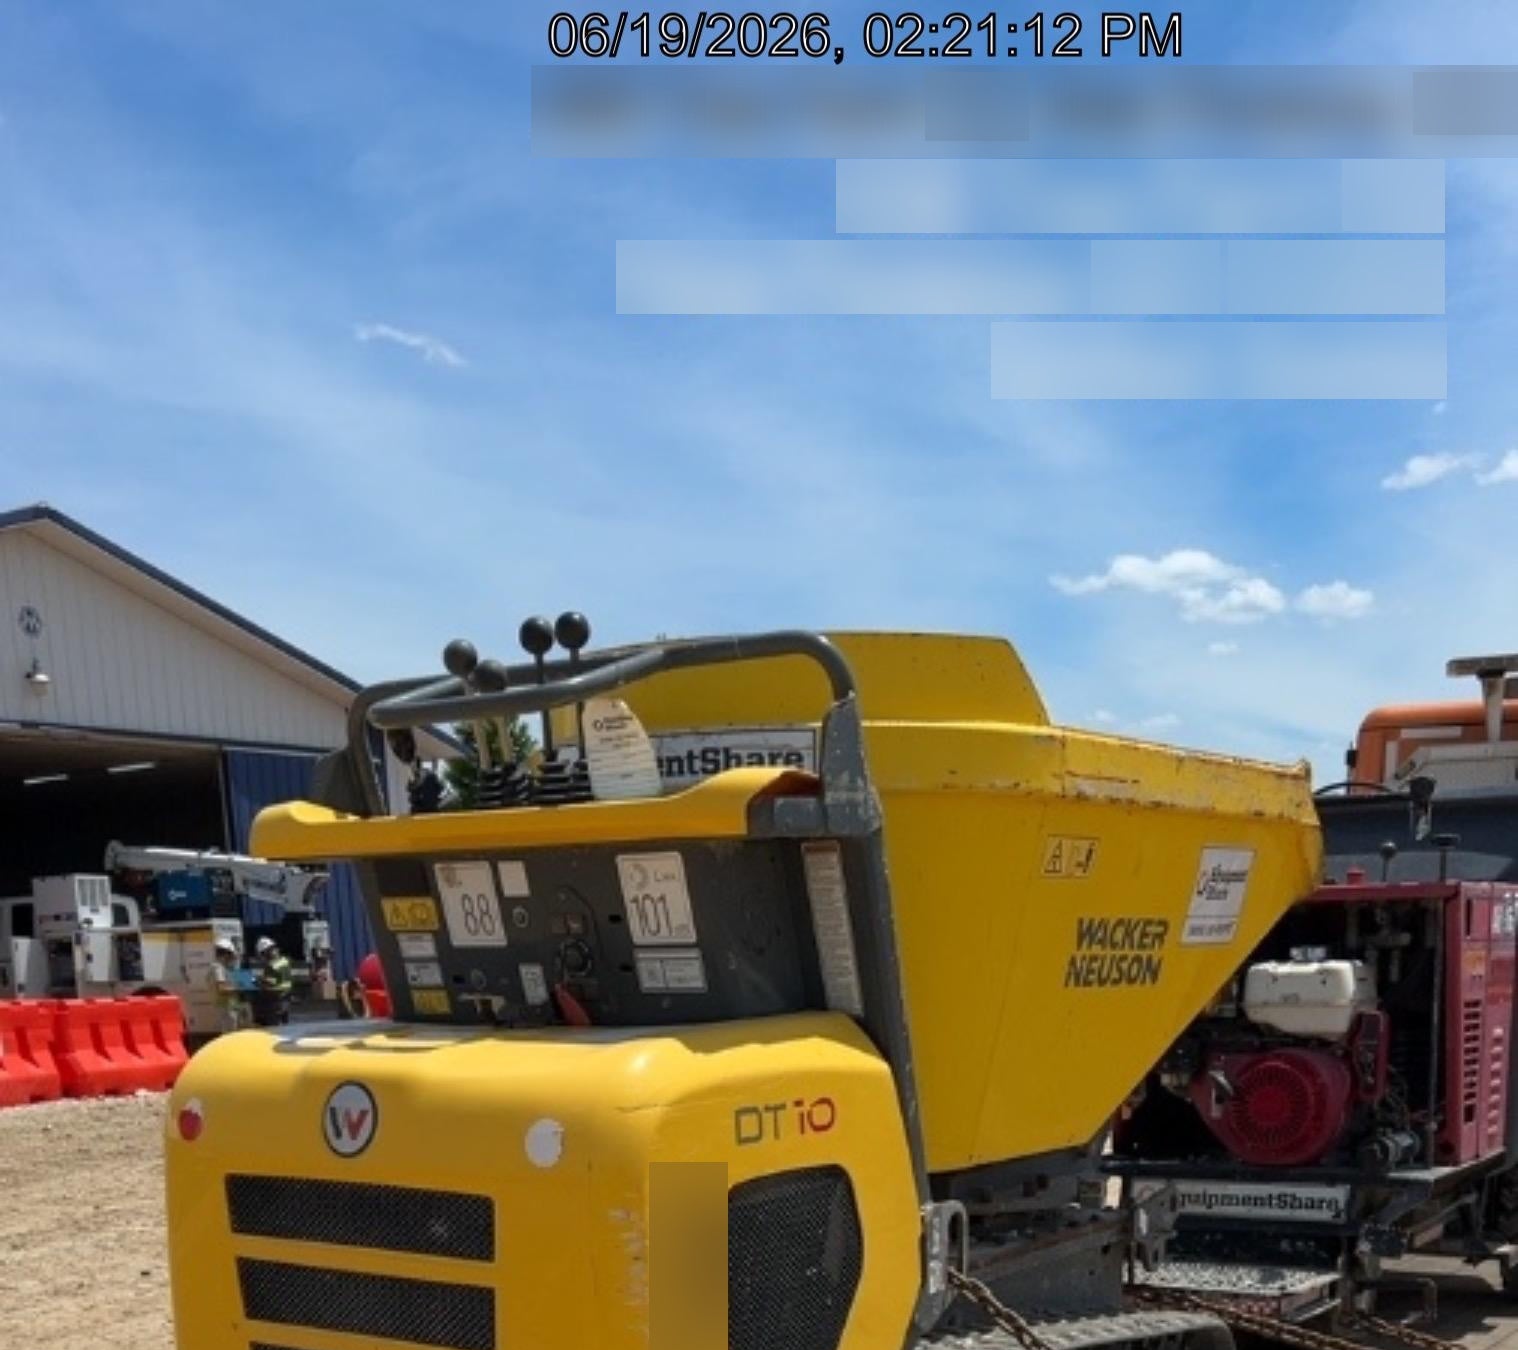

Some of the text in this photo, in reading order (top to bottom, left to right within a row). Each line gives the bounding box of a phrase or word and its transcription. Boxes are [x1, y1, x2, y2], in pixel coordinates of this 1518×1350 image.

[462, 893, 497, 936] 88
[629, 893, 673, 937] 101
[1076, 917, 1169, 952] WACKER
[1065, 954, 1163, 988] NEUSON
